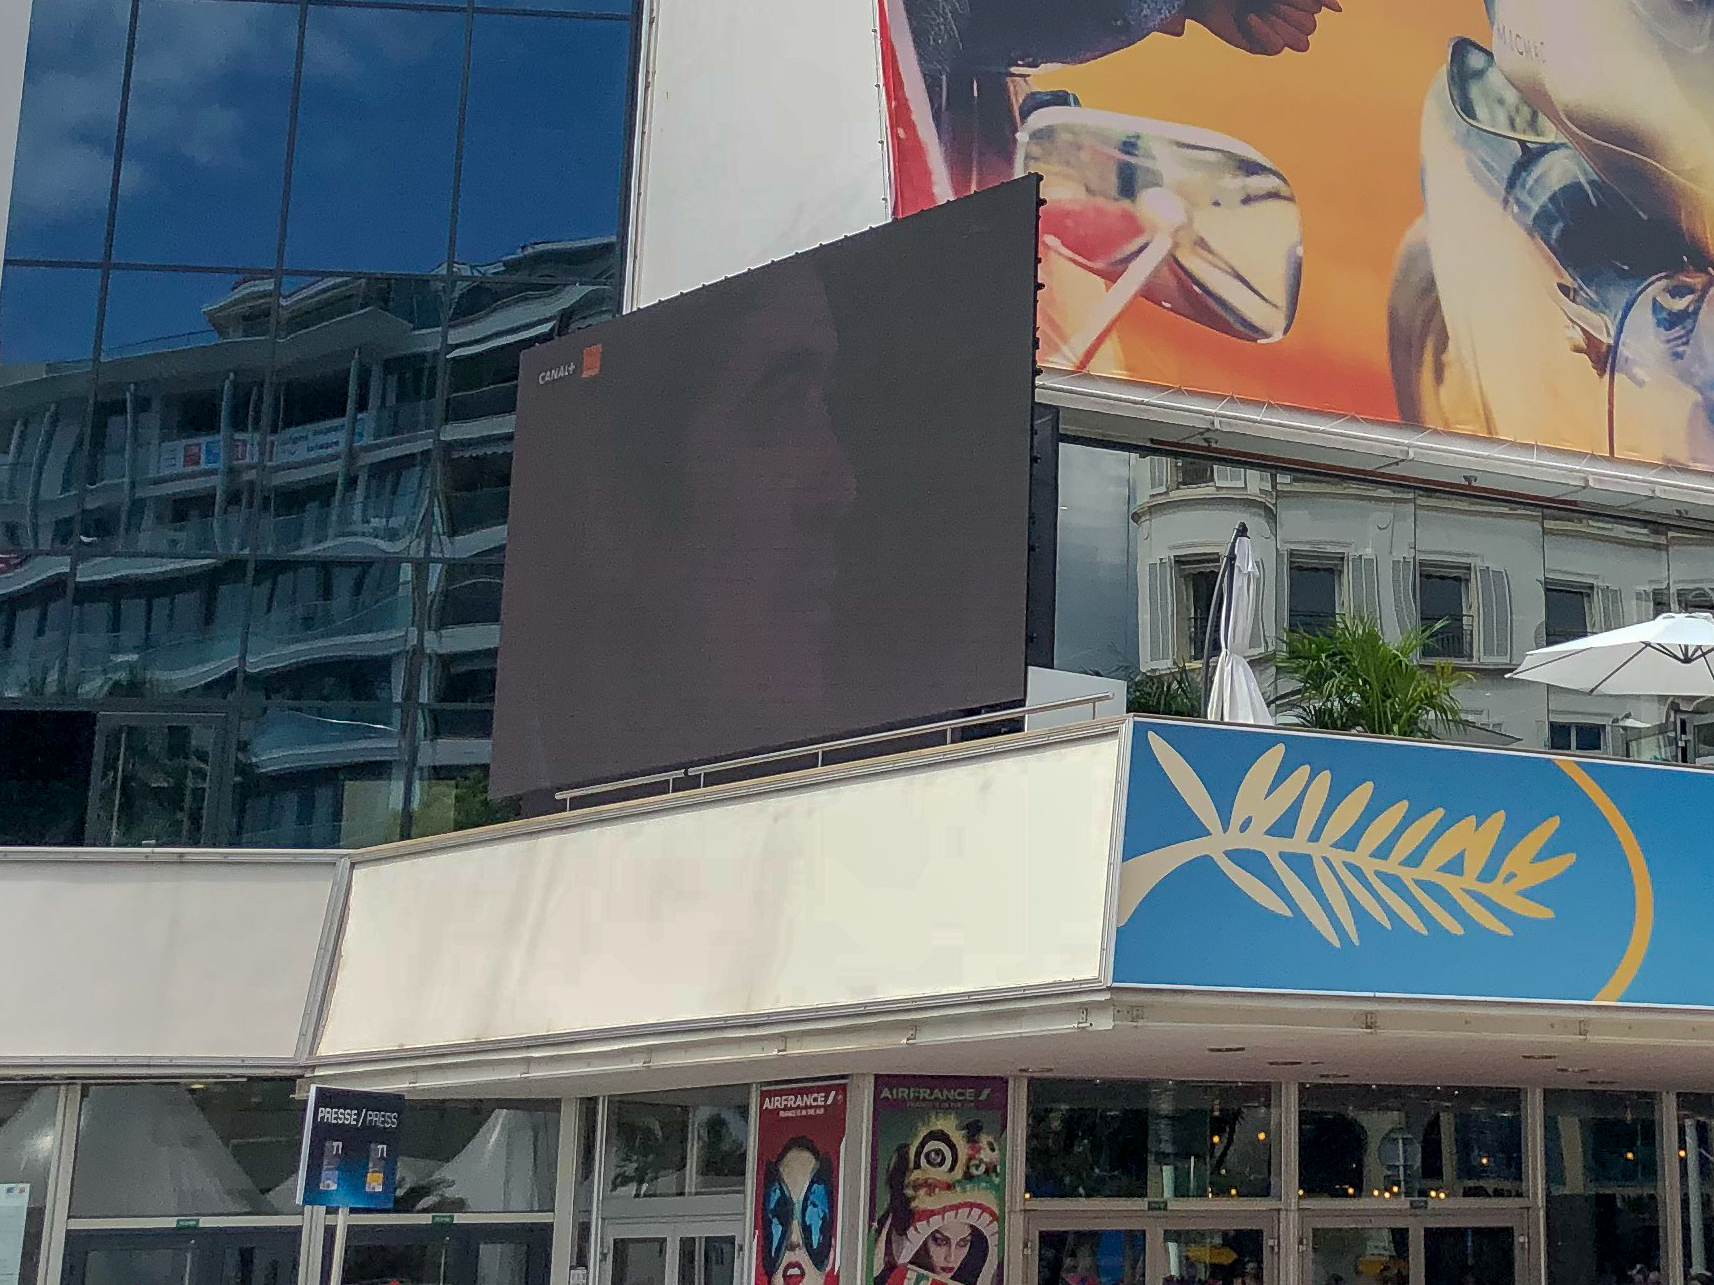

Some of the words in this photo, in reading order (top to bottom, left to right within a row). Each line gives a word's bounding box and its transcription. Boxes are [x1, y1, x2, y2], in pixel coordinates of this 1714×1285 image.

[538, 362, 576, 385] CANAL+
[317, 1107, 357, 1124] PRESSE
[366, 1110, 399, 1128] PRESS
